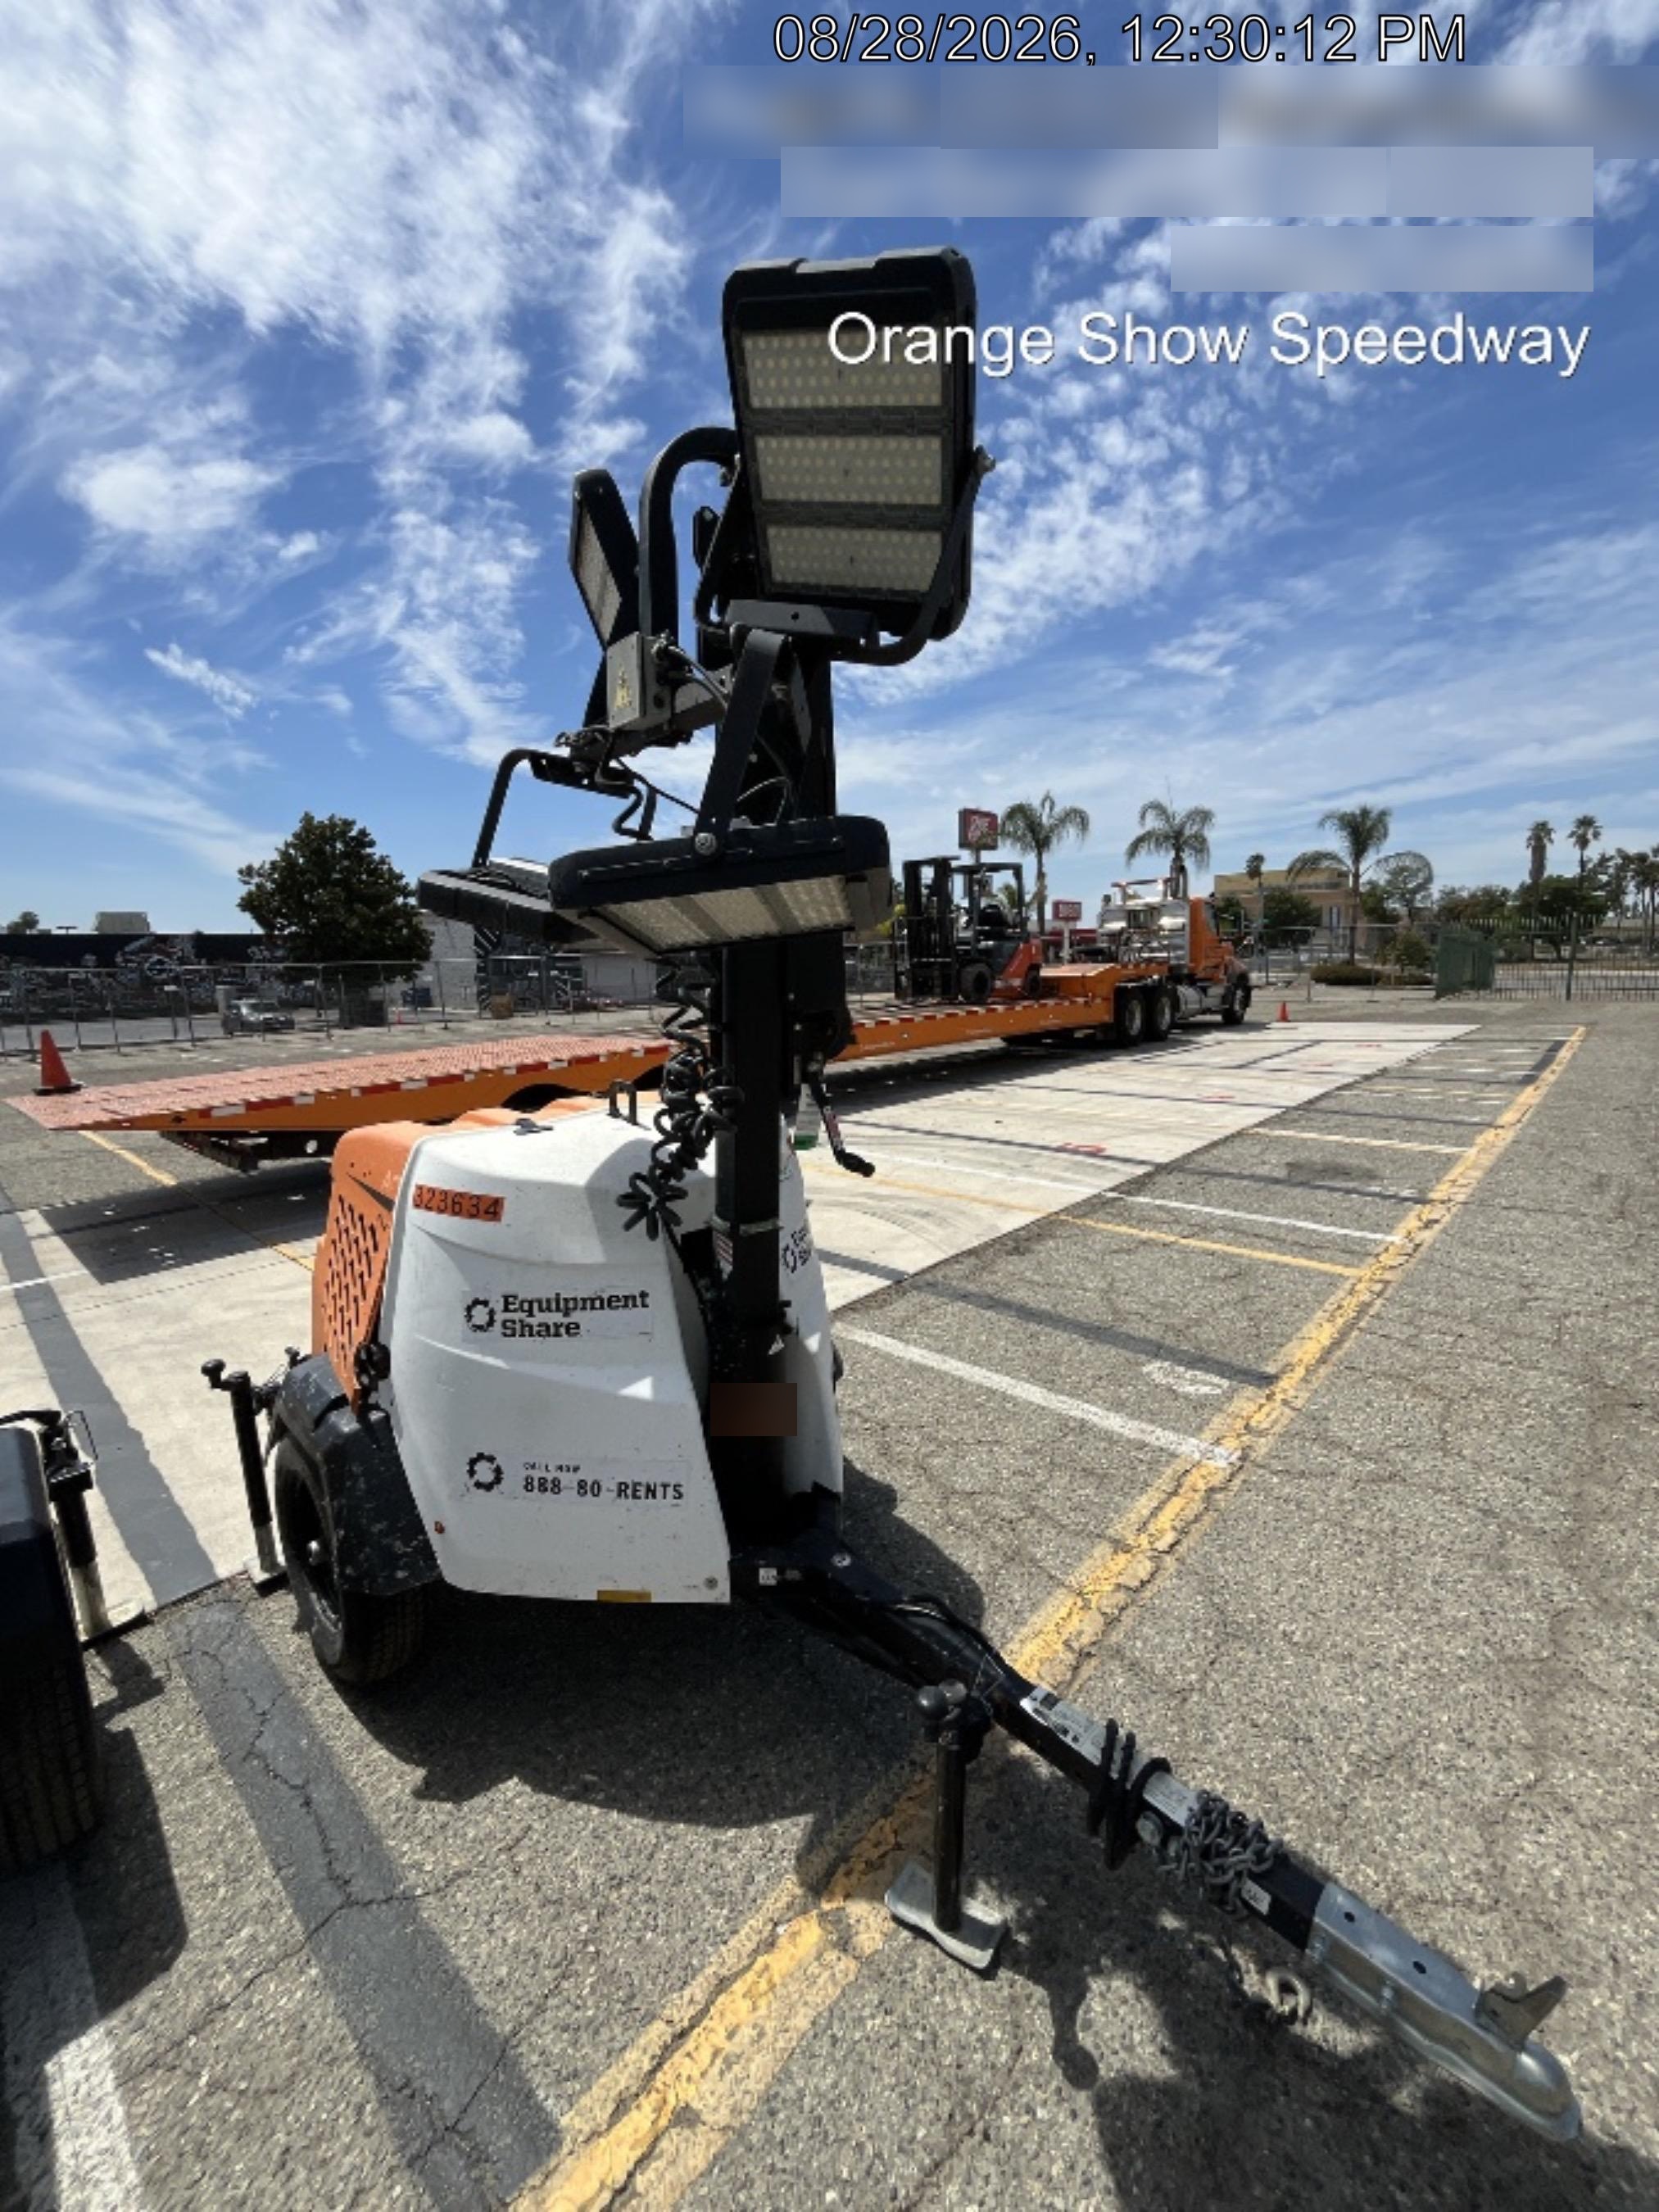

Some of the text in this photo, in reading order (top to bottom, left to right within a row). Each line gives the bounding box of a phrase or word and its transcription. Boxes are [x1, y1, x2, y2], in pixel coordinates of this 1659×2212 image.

[413, 1185, 502, 1220] 323634
[501, 1290, 650, 1318] Equipment
[501, 1319, 581, 1338] Share
